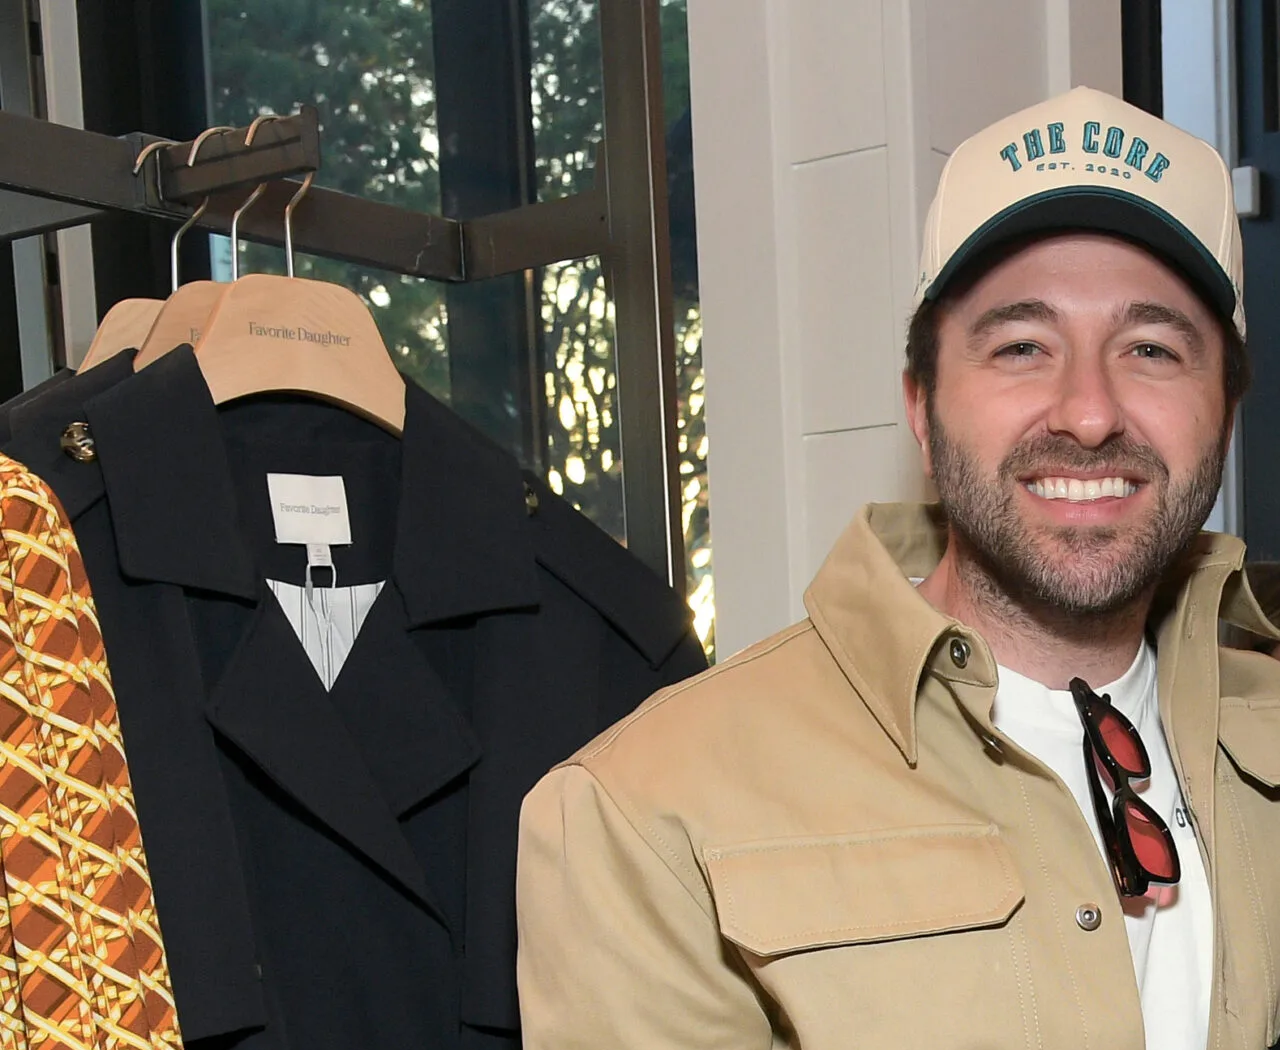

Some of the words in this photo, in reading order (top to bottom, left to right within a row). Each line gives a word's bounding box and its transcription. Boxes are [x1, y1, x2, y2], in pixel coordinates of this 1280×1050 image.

[1000, 122, 1066, 171] THE
[1082, 121, 1170, 183] CORE
[1036, 162, 1075, 172] EST.
[1085, 163, 1132, 179] 2020
[248, 321, 295, 340] Favorite
[297, 327, 351, 347] Daughter
